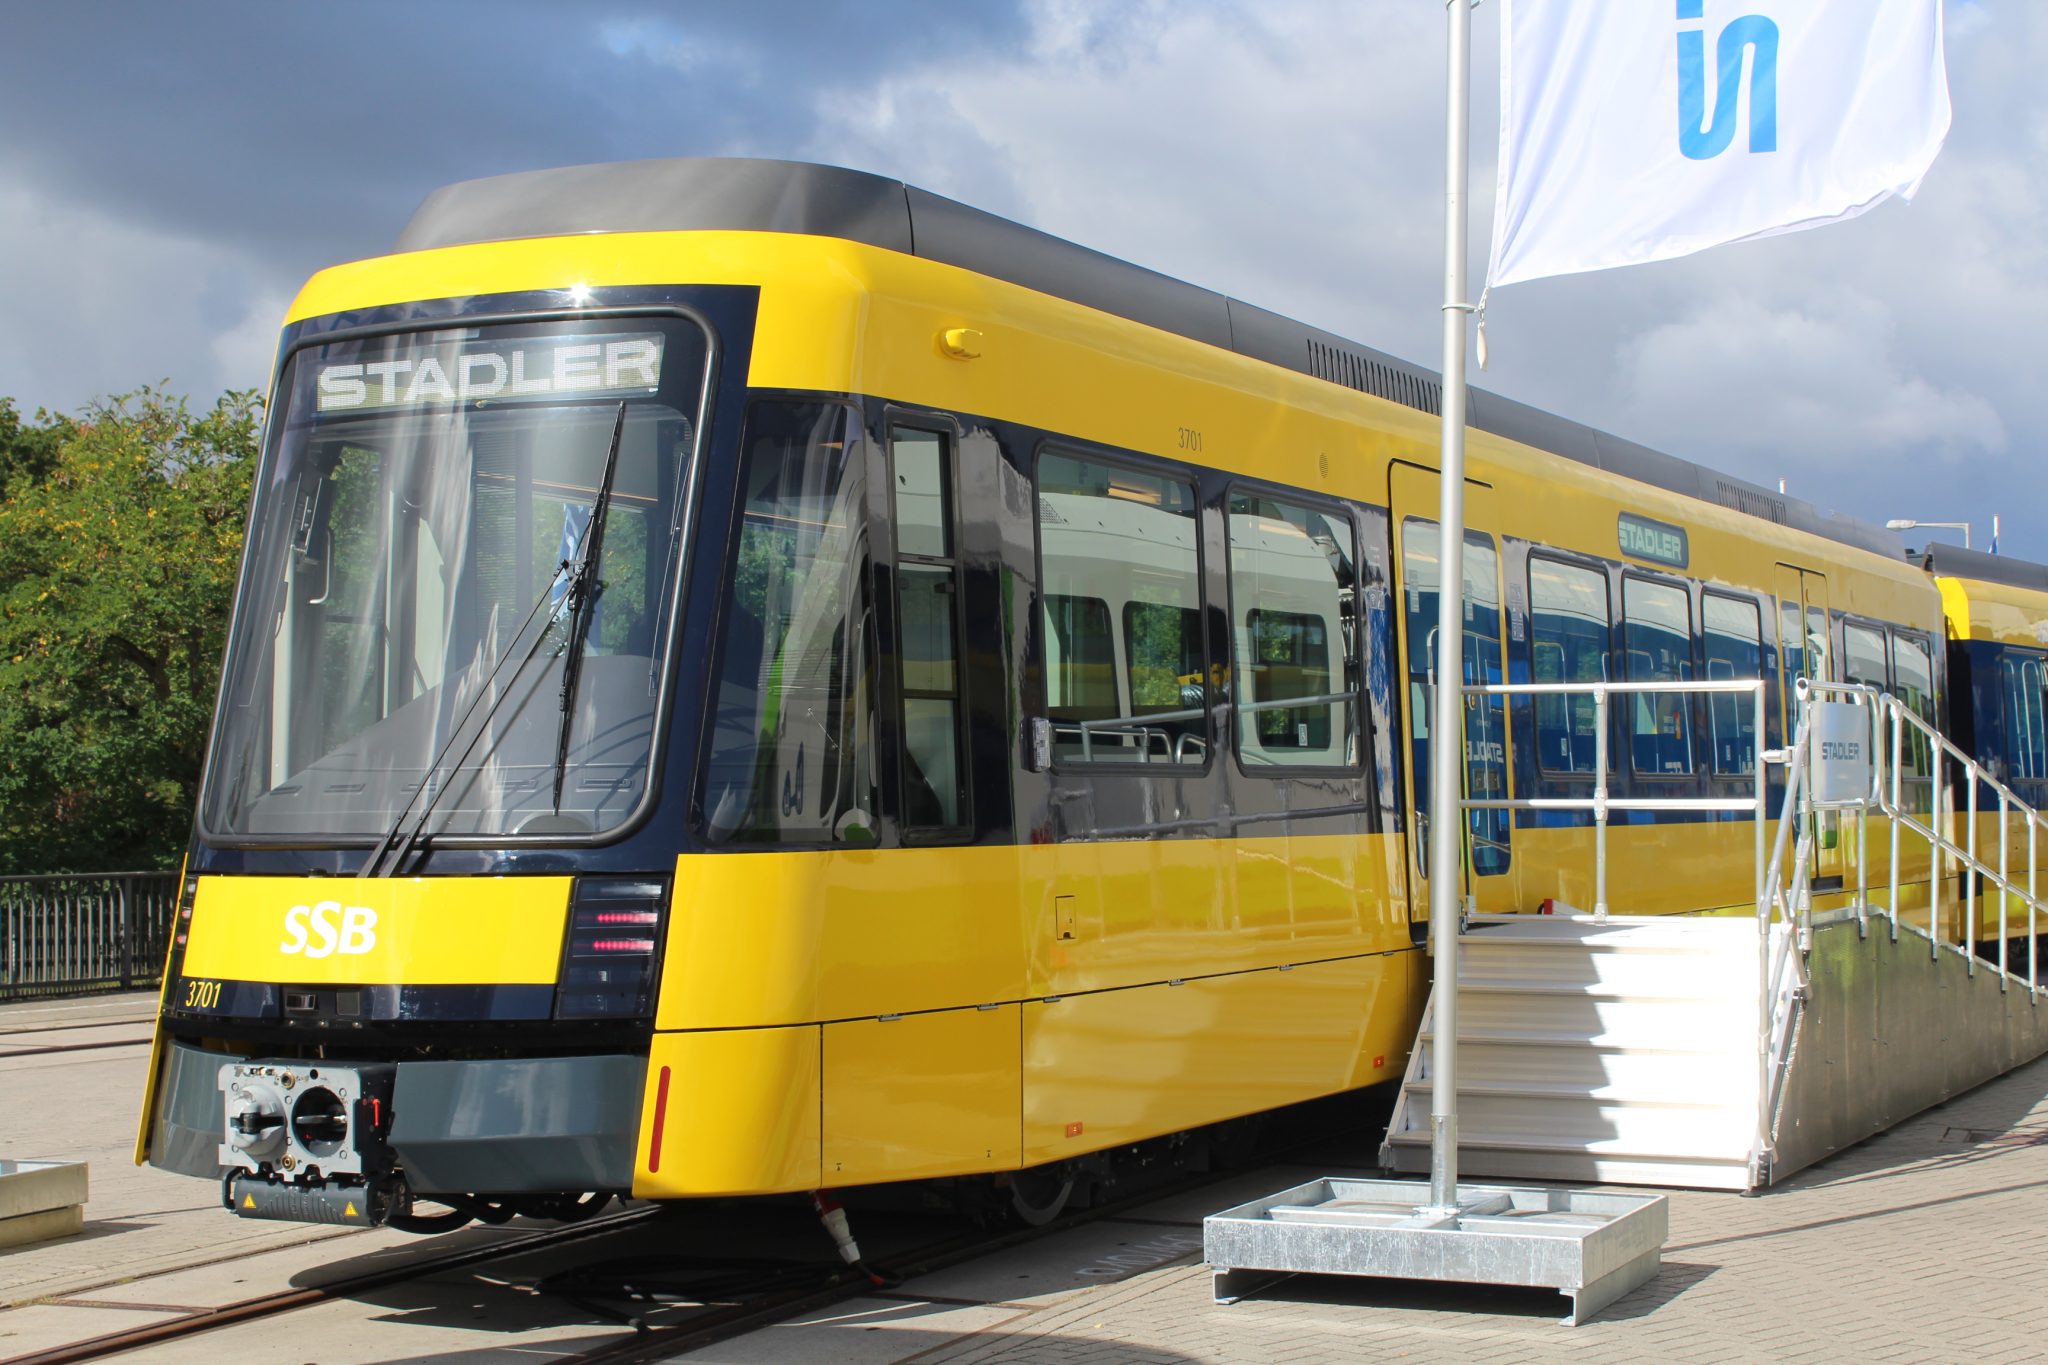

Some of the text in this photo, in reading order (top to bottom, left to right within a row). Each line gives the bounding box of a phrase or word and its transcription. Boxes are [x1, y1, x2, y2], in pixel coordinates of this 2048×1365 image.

[319, 339, 658, 409] STADLER
[1178, 427, 1202, 452] 3701
[1618, 521, 1682, 561] STADLER
[1822, 742, 1859, 760] STADLER
[280, 901, 378, 958] SSB
[185, 981, 222, 1009] 3701
